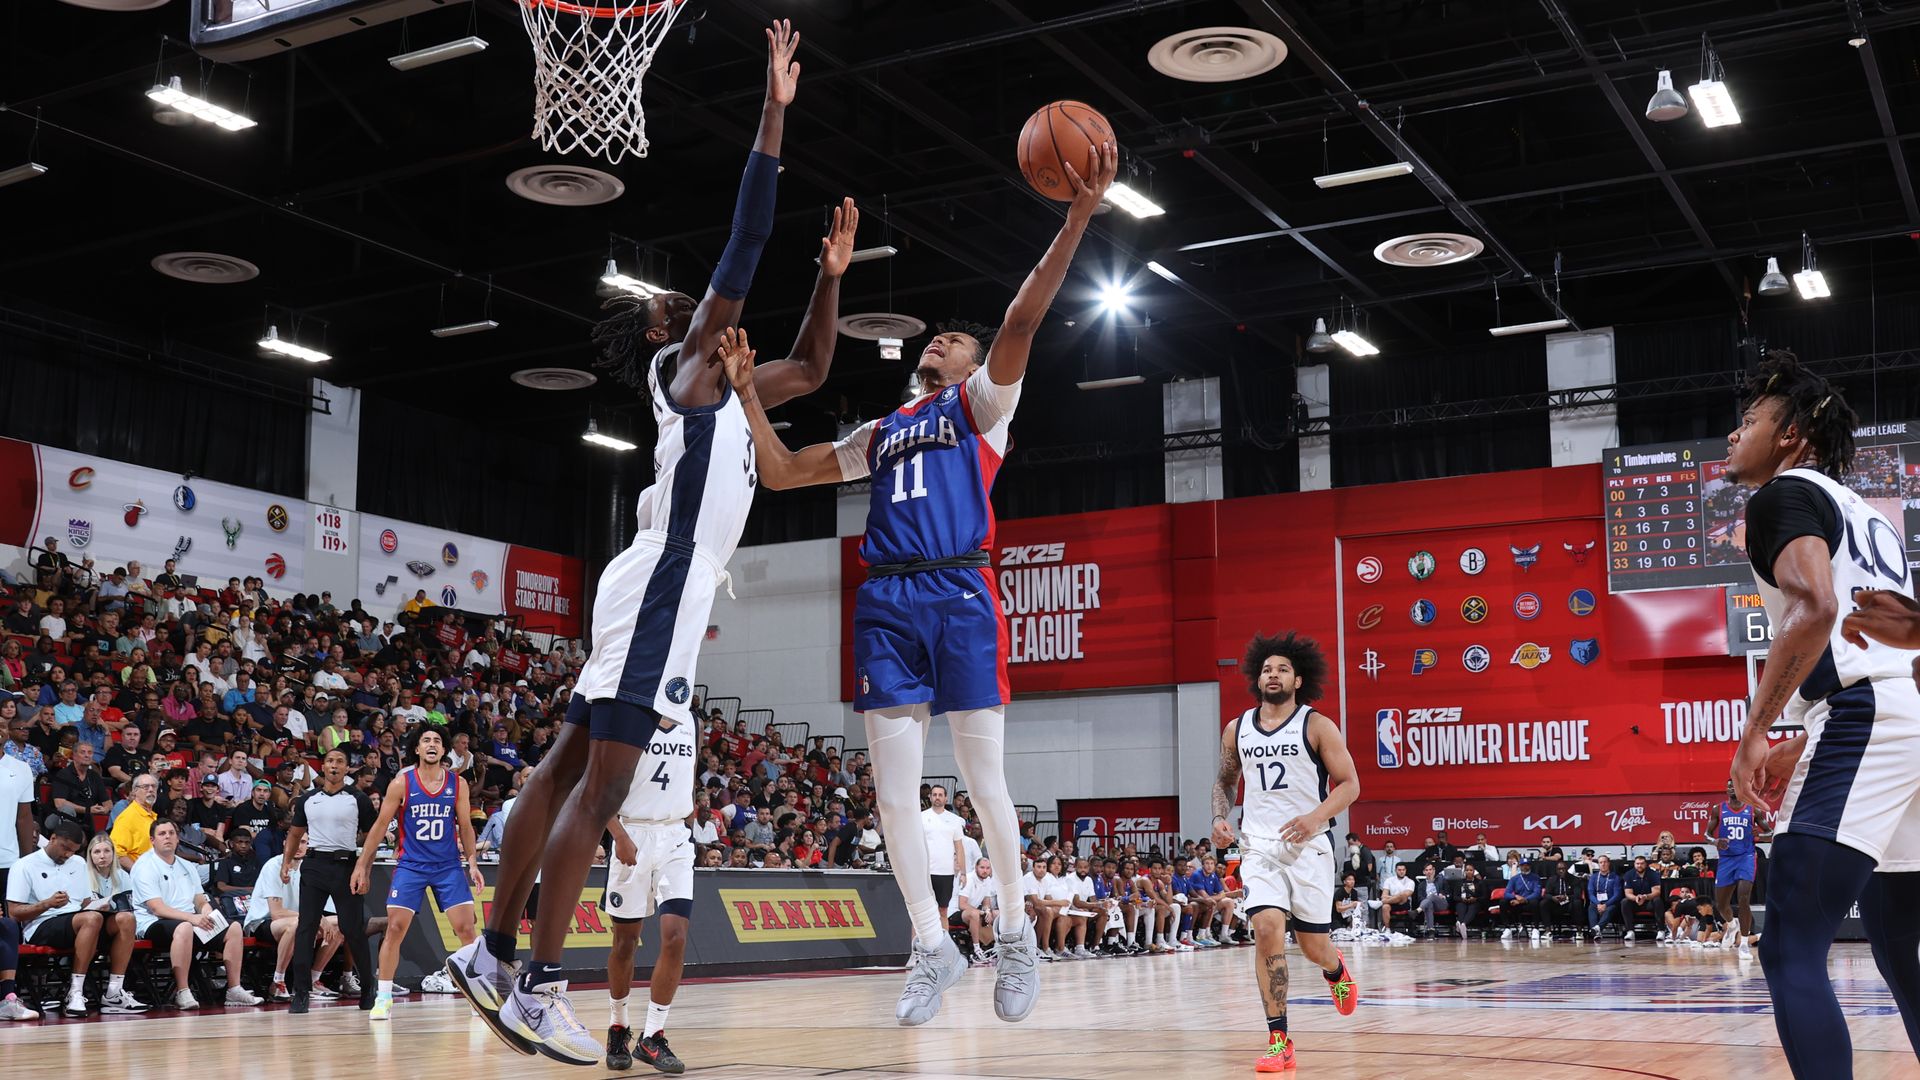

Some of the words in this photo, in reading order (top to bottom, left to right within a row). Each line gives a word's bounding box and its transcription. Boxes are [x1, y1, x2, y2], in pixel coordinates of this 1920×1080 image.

[1852, 426, 1876, 438] MMER
[1878, 423, 1907, 435] LEAGUE
[876, 415, 959, 471] PHILA
[1614, 456, 1621, 467] 1
[1624, 452, 1677, 467] Timberwolves
[1683, 450, 1691, 460] 0
[891, 451, 928, 504] 11
[1609, 479, 1625, 487] PLY
[1633, 477, 1648, 485] PTS
[1656, 475, 1672, 483] REB
[1680, 472, 1695, 480] FLS
[1610, 490, 1625, 501] 00
[1637, 488, 1645, 499] 7
[1660, 485, 1669, 497] 3
[1687, 483, 1693, 494] 1
[1614, 507, 1623, 518] 4
[1638, 506, 1646, 518] 3
[1661, 504, 1669, 515] 6
[1686, 501, 1694, 512] 3
[323, 513, 341, 529] 118
[1613, 525, 1627, 536] 12
[1636, 522, 1650, 534] 16
[1662, 521, 1670, 532] 7
[1687, 518, 1695, 530] 3
[322, 536, 340, 551] 119
[1613, 541, 1628, 552] 20
[1640, 540, 1648, 551] 0
[1663, 538, 1671, 549] 0
[1687, 537, 1695, 548] 0
[1000, 542, 1066, 565] 2K25
[1614, 558, 1629, 569] 33
[1637, 557, 1652, 568] 19
[1661, 556, 1676, 567] 10
[1689, 554, 1697, 565] 5
[515, 569, 559, 594] TOMORROW'S
[1000, 562, 1101, 616] SUMMER
[515, 589, 536, 609] STARS
[537, 592, 553, 613] PLAY
[554, 595, 570, 615] HERE
[1008, 613, 1084, 663] EAGUE
[1406, 707, 1462, 724] 2K25
[1660, 699, 1748, 744] TOMOR
[1242, 744, 1299, 758] WOLVES
[1406, 723, 1503, 766] SUMMER
[1507, 720, 1590, 763] LEAGUE
[1381, 754, 1394, 764] NBA
[650, 761, 670, 791] 4
[1256, 761, 1288, 791] 12
[411, 803, 451, 818] PHILA
[1673, 810, 1709, 820] ULTR
[1114, 817, 1161, 831] 2K25
[1605, 808, 1651, 832] Vegas
[1723, 816, 1749, 827] PHILA
[416, 819, 444, 840] 20
[1366, 824, 1410, 836] Hennessy
[1727, 826, 1744, 840] 30
[733, 900, 865, 931] PANINI
